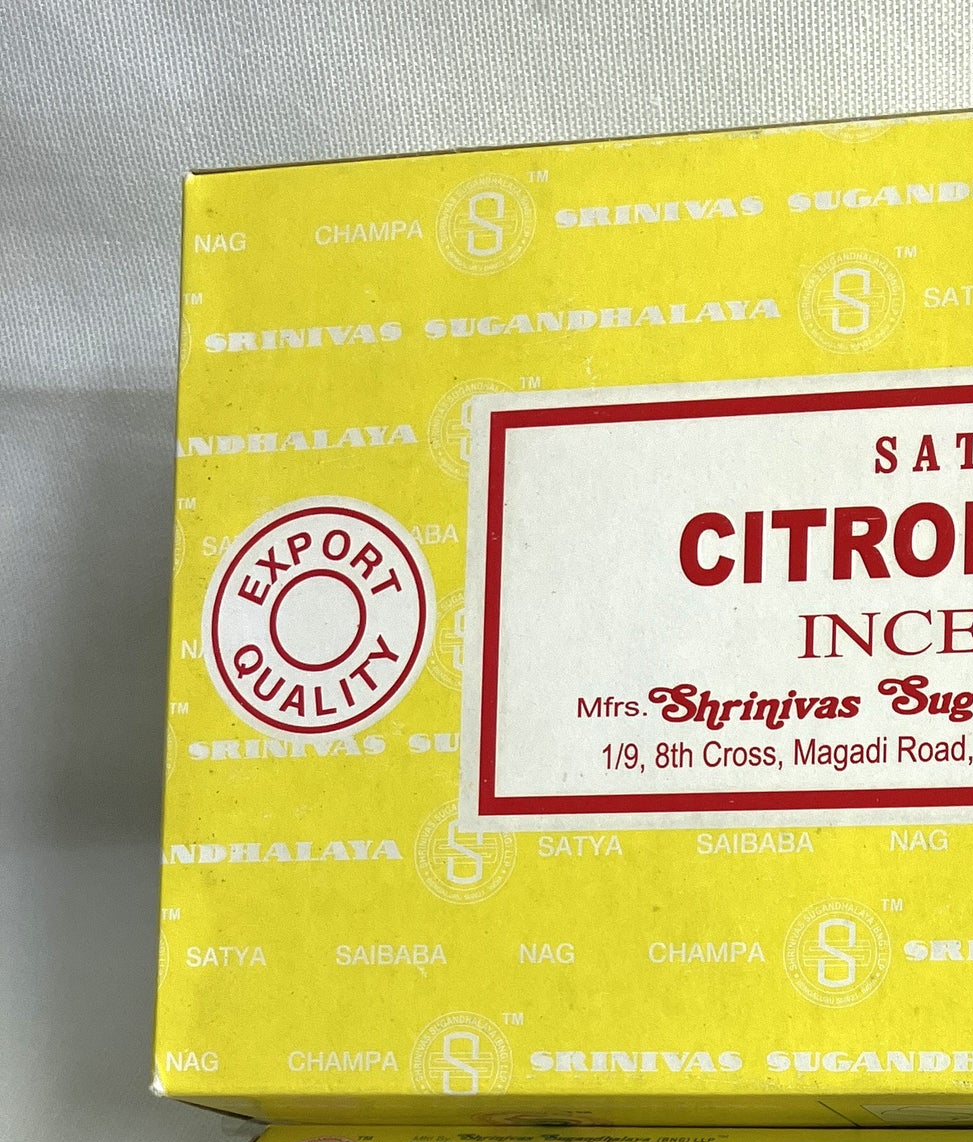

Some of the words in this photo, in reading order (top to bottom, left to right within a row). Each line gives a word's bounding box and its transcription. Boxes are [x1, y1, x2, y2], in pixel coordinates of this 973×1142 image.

[555, 194, 763, 229] SRINIVAS
[194, 233, 247, 253] NAG
[315, 221, 423, 246] CHAMPA
[205, 321, 402, 352] SRINIVAS
[425, 298, 781, 339] SUGANDHALAYA
[238, 530, 401, 606] EXPORT
[234, 635, 399, 717] QUALITY
[577, 697, 648, 719] Mfrs.
[648, 684, 860, 730] Shrinivas
[602, 743, 646, 773] 1/9,
[655, 742, 693, 768] 8th
[703, 738, 783, 769] Cross,
[794, 737, 887, 772] Magadi
[899, 734, 973, 765] Road,
[538, 835, 622, 857] SATYA
[697, 832, 814, 854] SAIBABA
[890, 830, 948, 851] NAG
[186, 946, 267, 967] SATYA
[336, 944, 447, 966] SAIBABA
[519, 944, 575, 963] NAG
[649, 942, 765, 964] CHAMPA
[166, 1052, 218, 1071] NAG
[289, 1051, 398, 1072] CHAMPA
[531, 1051, 742, 1072] SRINIVAS
